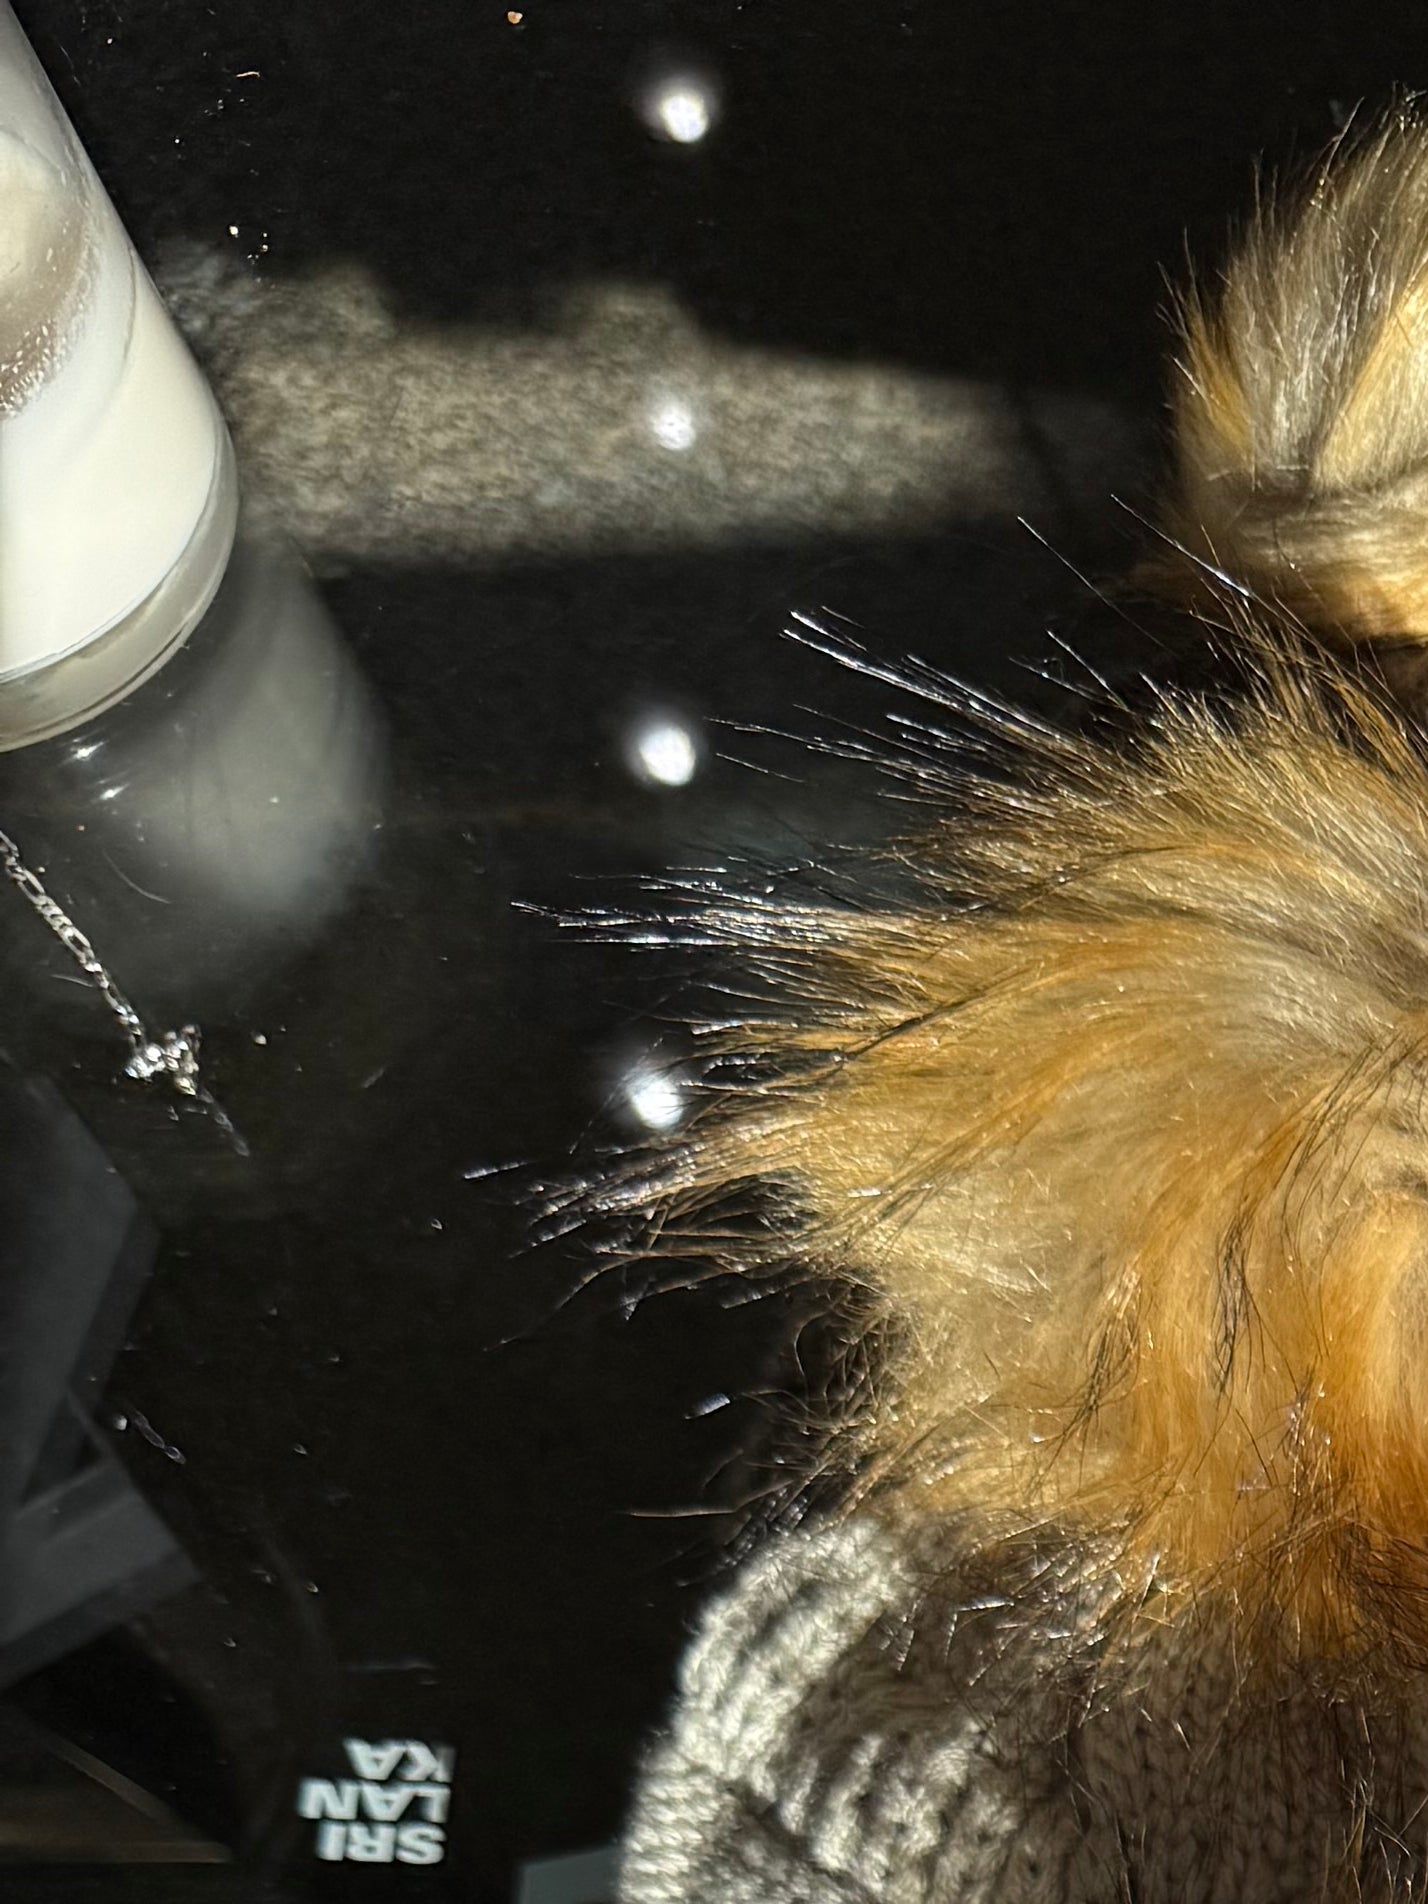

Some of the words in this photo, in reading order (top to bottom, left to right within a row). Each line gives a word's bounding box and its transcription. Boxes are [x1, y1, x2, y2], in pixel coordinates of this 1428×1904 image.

[341, 1737, 457, 1782] KA
[295, 1776, 453, 1824] LAN
[315, 1819, 447, 1866] SRI
